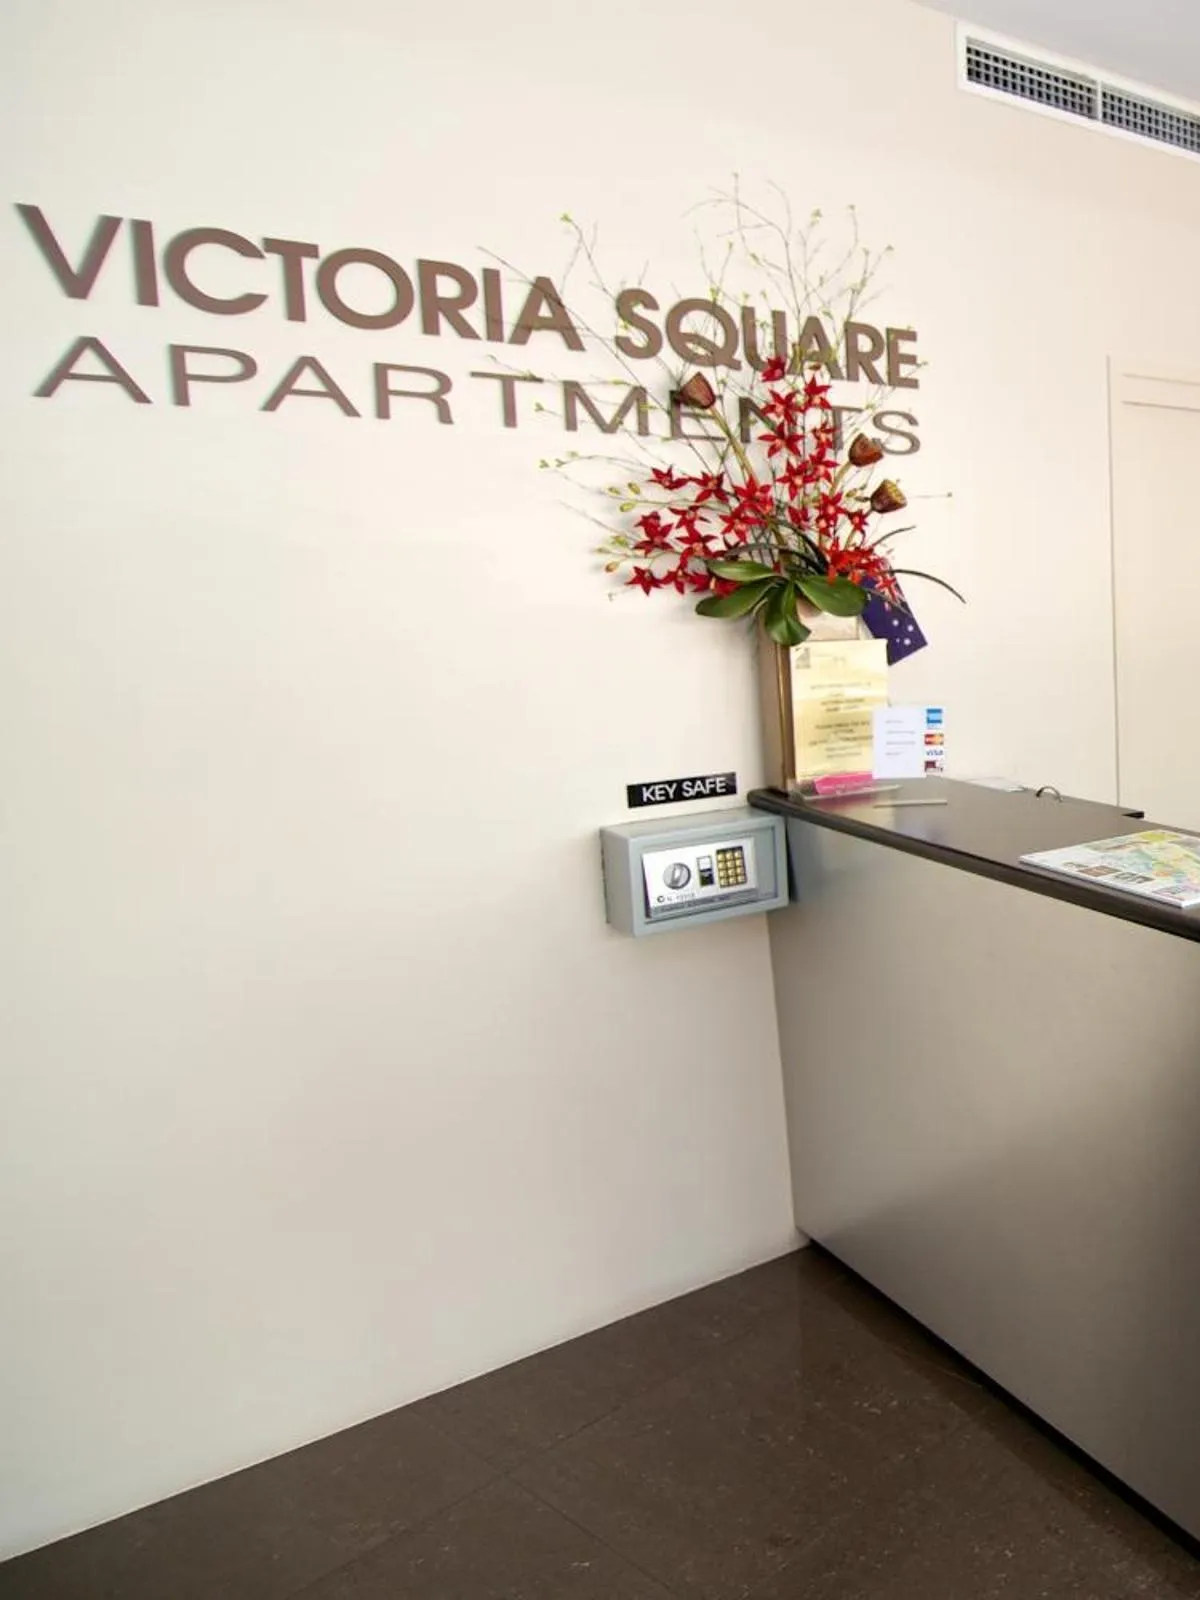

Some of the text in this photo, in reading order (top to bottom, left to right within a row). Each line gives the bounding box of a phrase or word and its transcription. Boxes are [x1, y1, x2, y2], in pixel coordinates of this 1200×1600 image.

[16, 202, 919, 389] VICTORIA SQUARE
[34, 335, 922, 456] APARTMENTS
[642, 777, 727, 803] KEY SAFE
